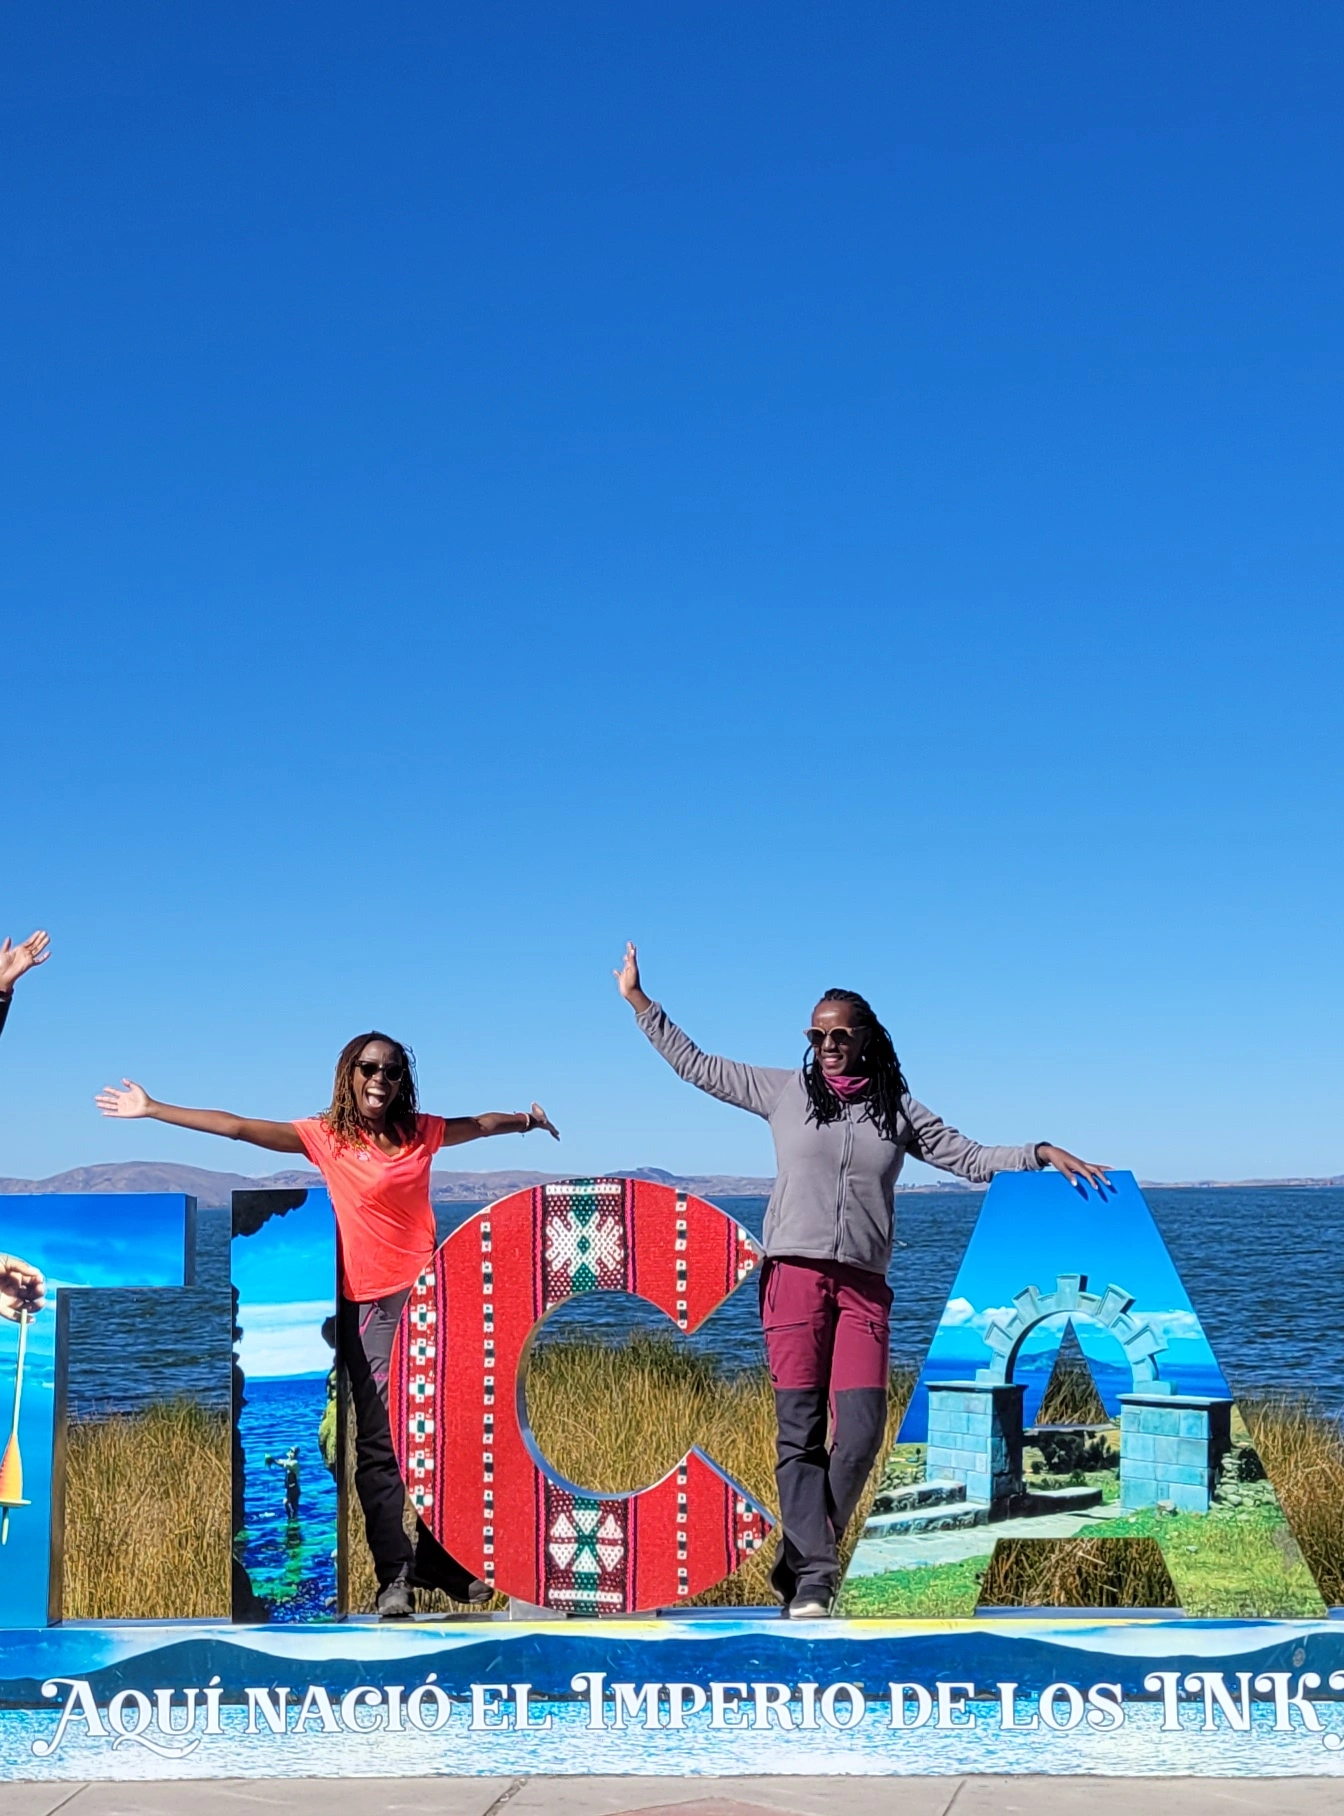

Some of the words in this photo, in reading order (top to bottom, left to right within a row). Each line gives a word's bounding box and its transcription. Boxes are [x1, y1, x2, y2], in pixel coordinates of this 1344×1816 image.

[31, 1675, 225, 1760] AQUÍ
[244, 1672, 454, 1735] NACIÓ
[467, 1682, 553, 1732] EL
[886, 1680, 976, 1731] DE
[996, 1680, 1127, 1732] LOS
